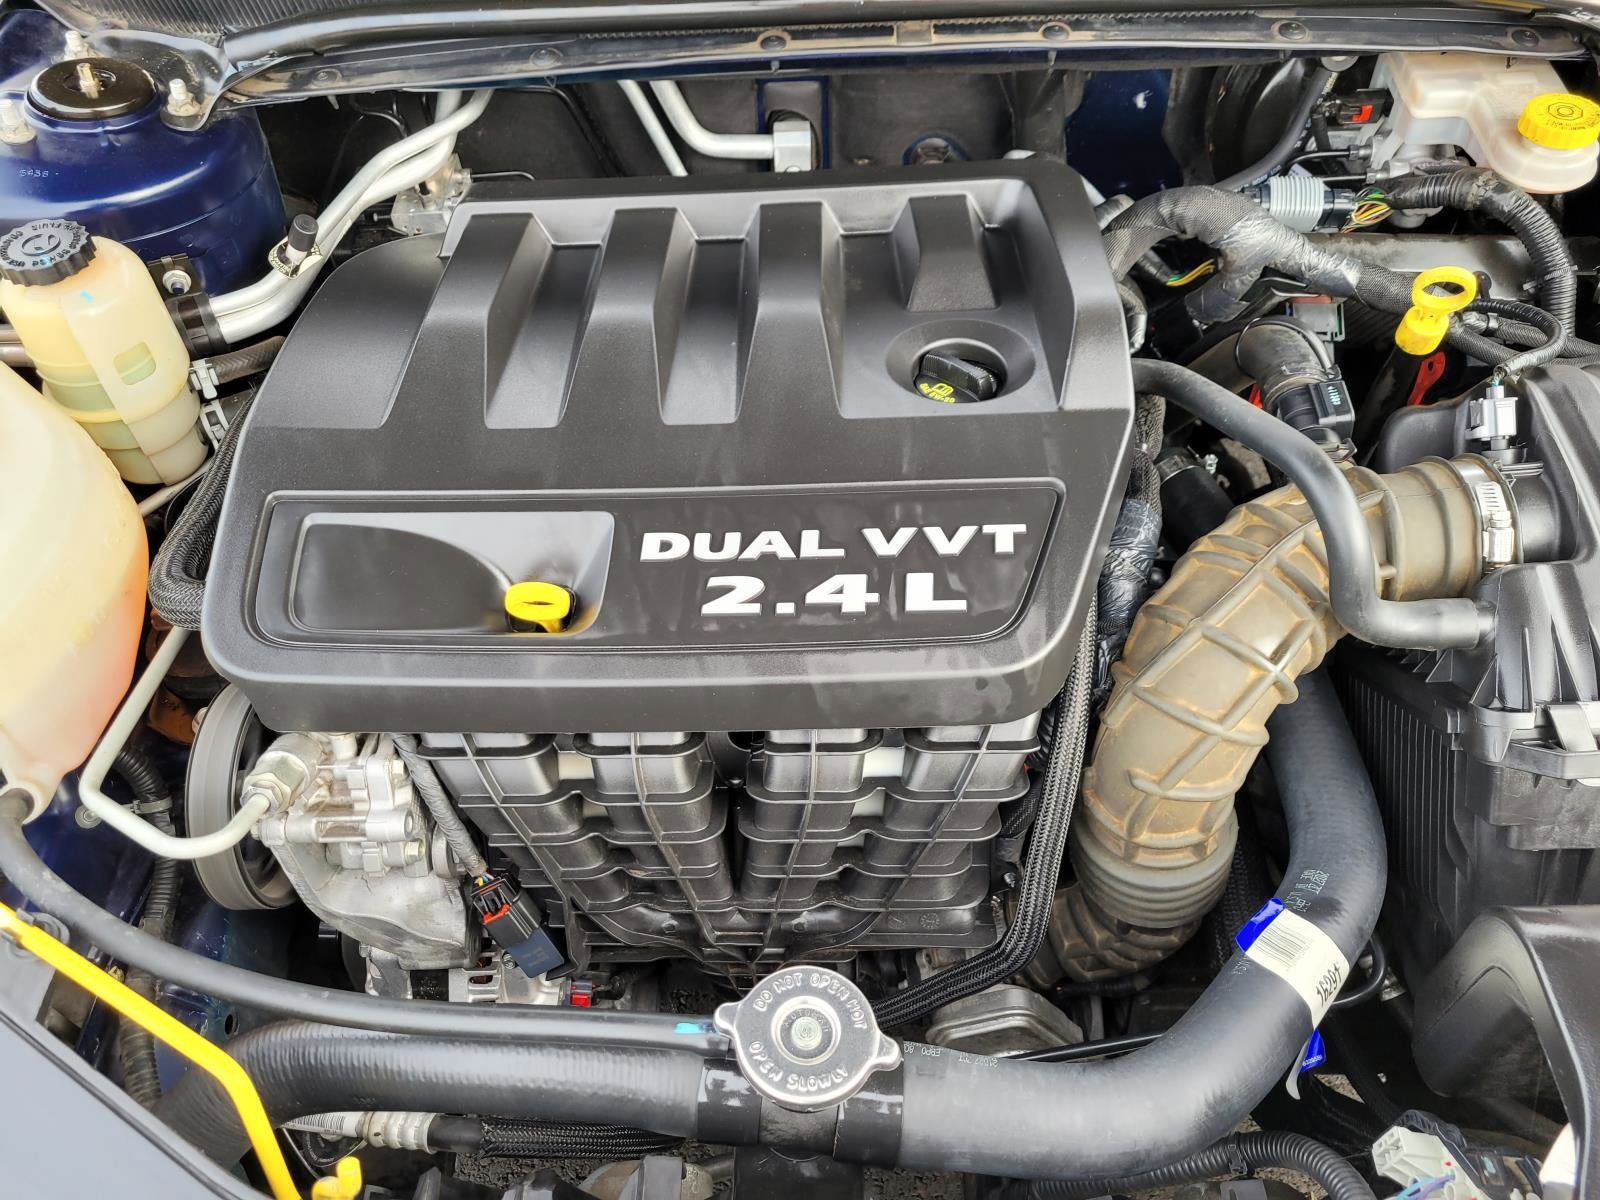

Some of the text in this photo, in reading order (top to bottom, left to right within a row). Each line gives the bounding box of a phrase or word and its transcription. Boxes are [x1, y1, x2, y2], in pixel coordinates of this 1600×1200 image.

[639, 523, 1028, 562] DUAL VVT
[753, 989, 774, 1012] DO
[773, 972, 803, 995] NOT
[809, 973, 850, 1000] OPEN
[845, 999, 868, 1030] HOT
[750, 1040, 849, 1092] OPEN SLOWLY
